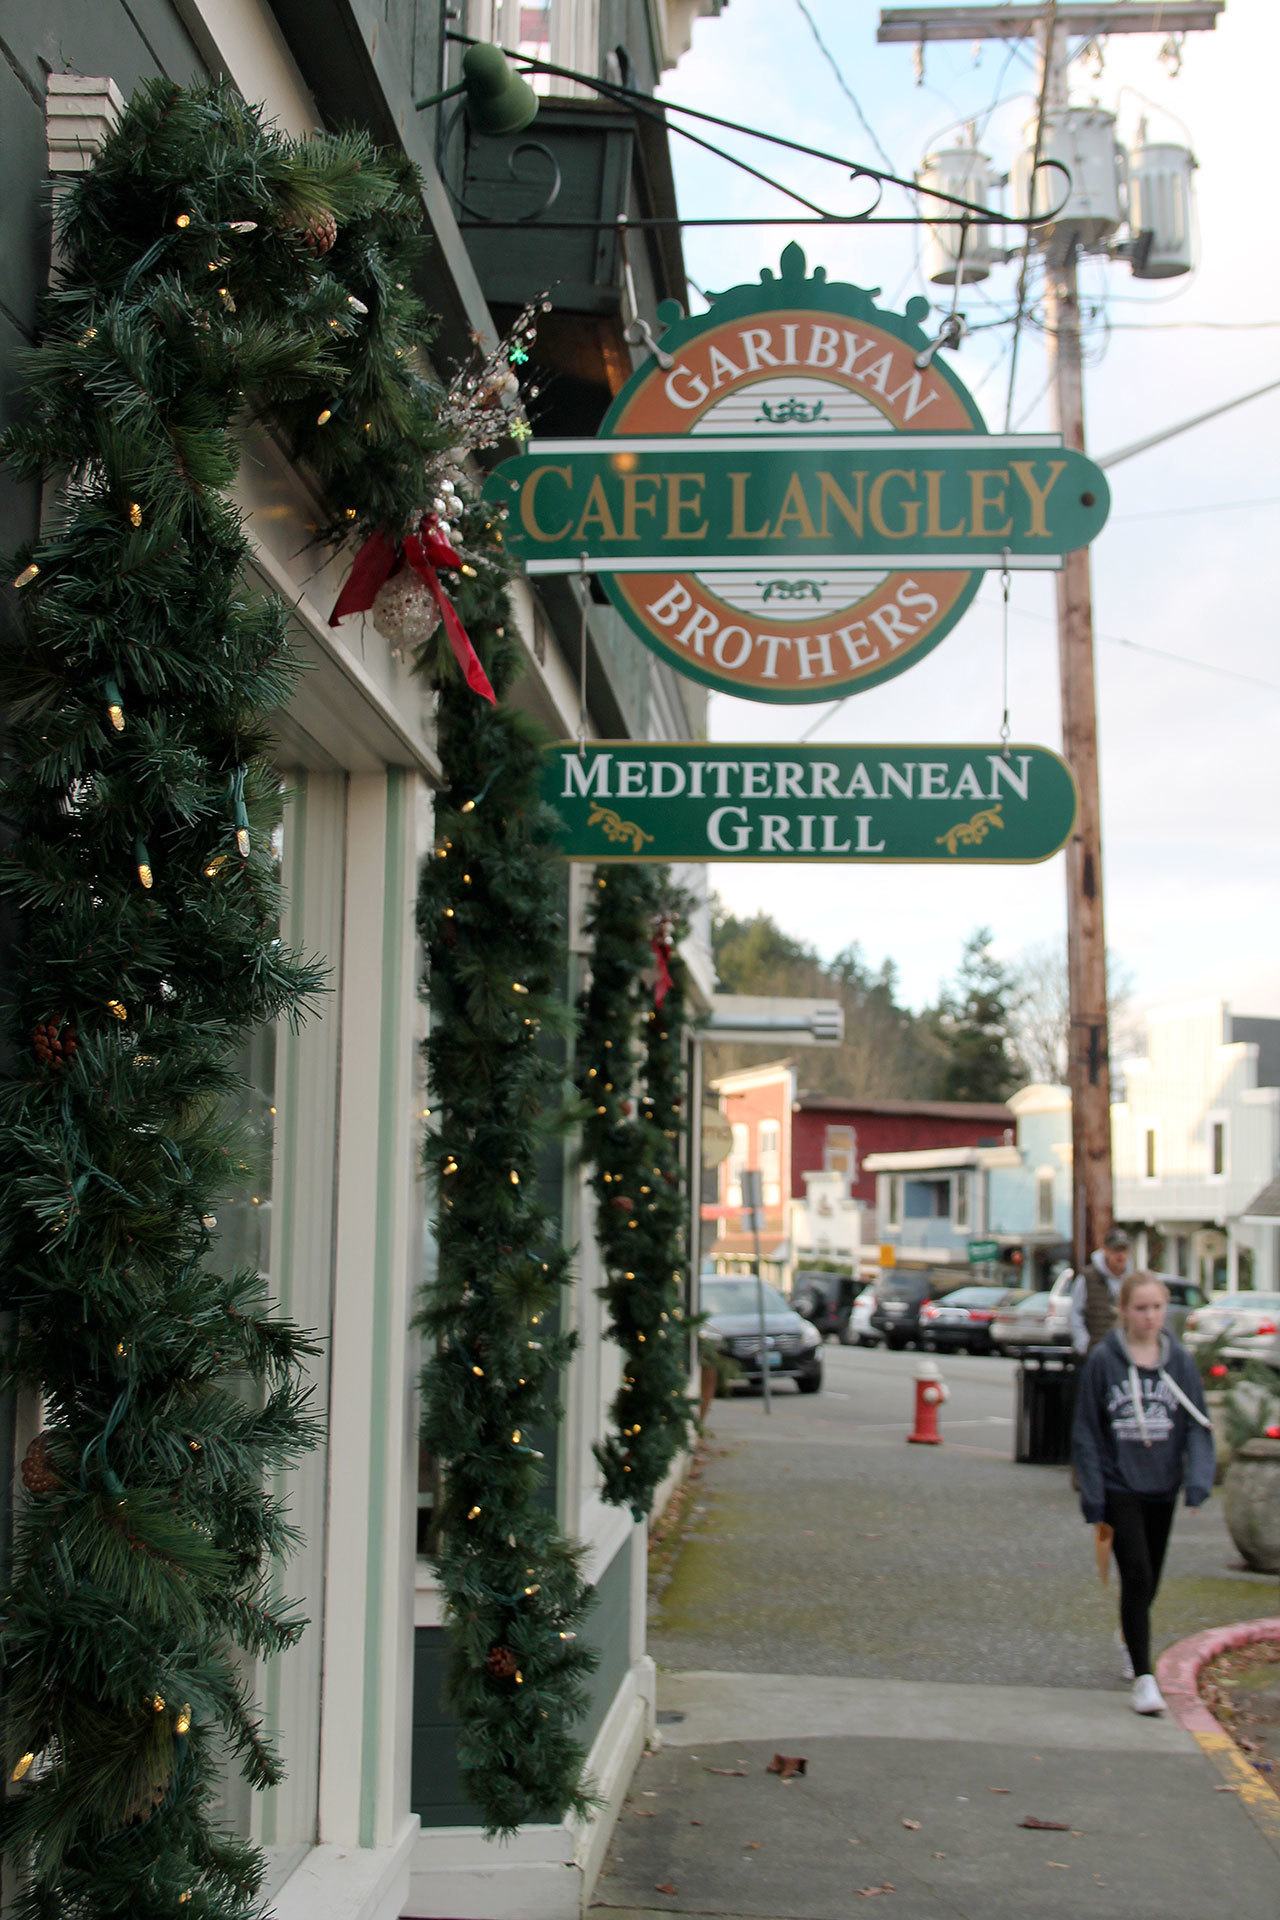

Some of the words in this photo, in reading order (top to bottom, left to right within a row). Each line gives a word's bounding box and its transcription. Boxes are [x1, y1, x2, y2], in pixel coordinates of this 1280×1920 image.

[664, 324, 937, 420] GARIBYAN
[520, 465, 708, 542] CAFE
[728, 460, 1066, 539] LANGLEY
[648, 580, 939, 679] BROTHERS
[562, 753, 1031, 800] MEDITERRANEAN
[707, 806, 886, 852] GRILL
